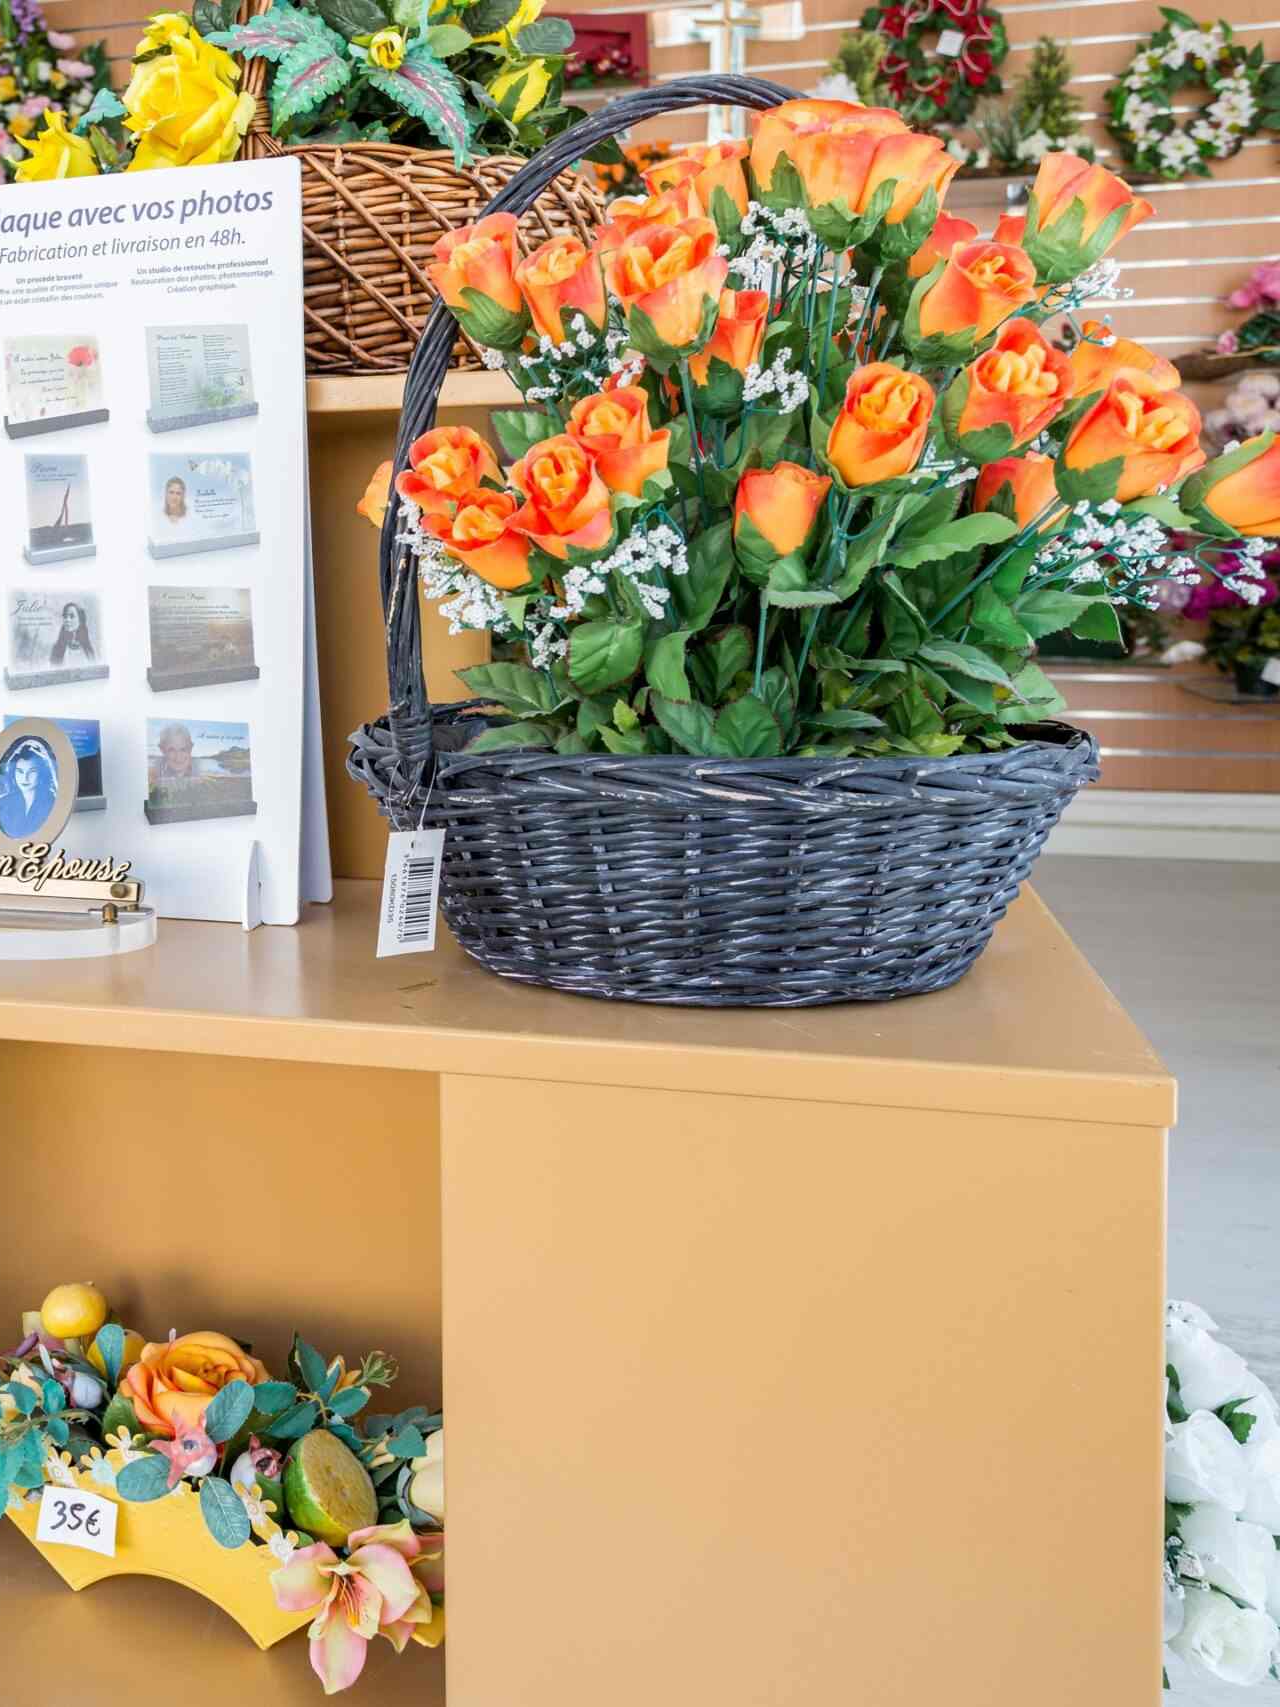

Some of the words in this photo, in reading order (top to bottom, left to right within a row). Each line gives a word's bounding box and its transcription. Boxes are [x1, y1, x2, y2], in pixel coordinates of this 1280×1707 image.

[67, 203, 126, 227] avec
[132, 199, 174, 221] vos
[179, 189, 273, 224] photos
[0, 239, 88, 264] Fabrication
[91, 239, 107, 256] et
[111, 235, 180, 255] livraison
[184, 234, 205, 249] en
[209, 226, 246, 247] 48h.
[16, 842, 131, 891] Epouse
[50, 1500, 101, 1537] 35€
